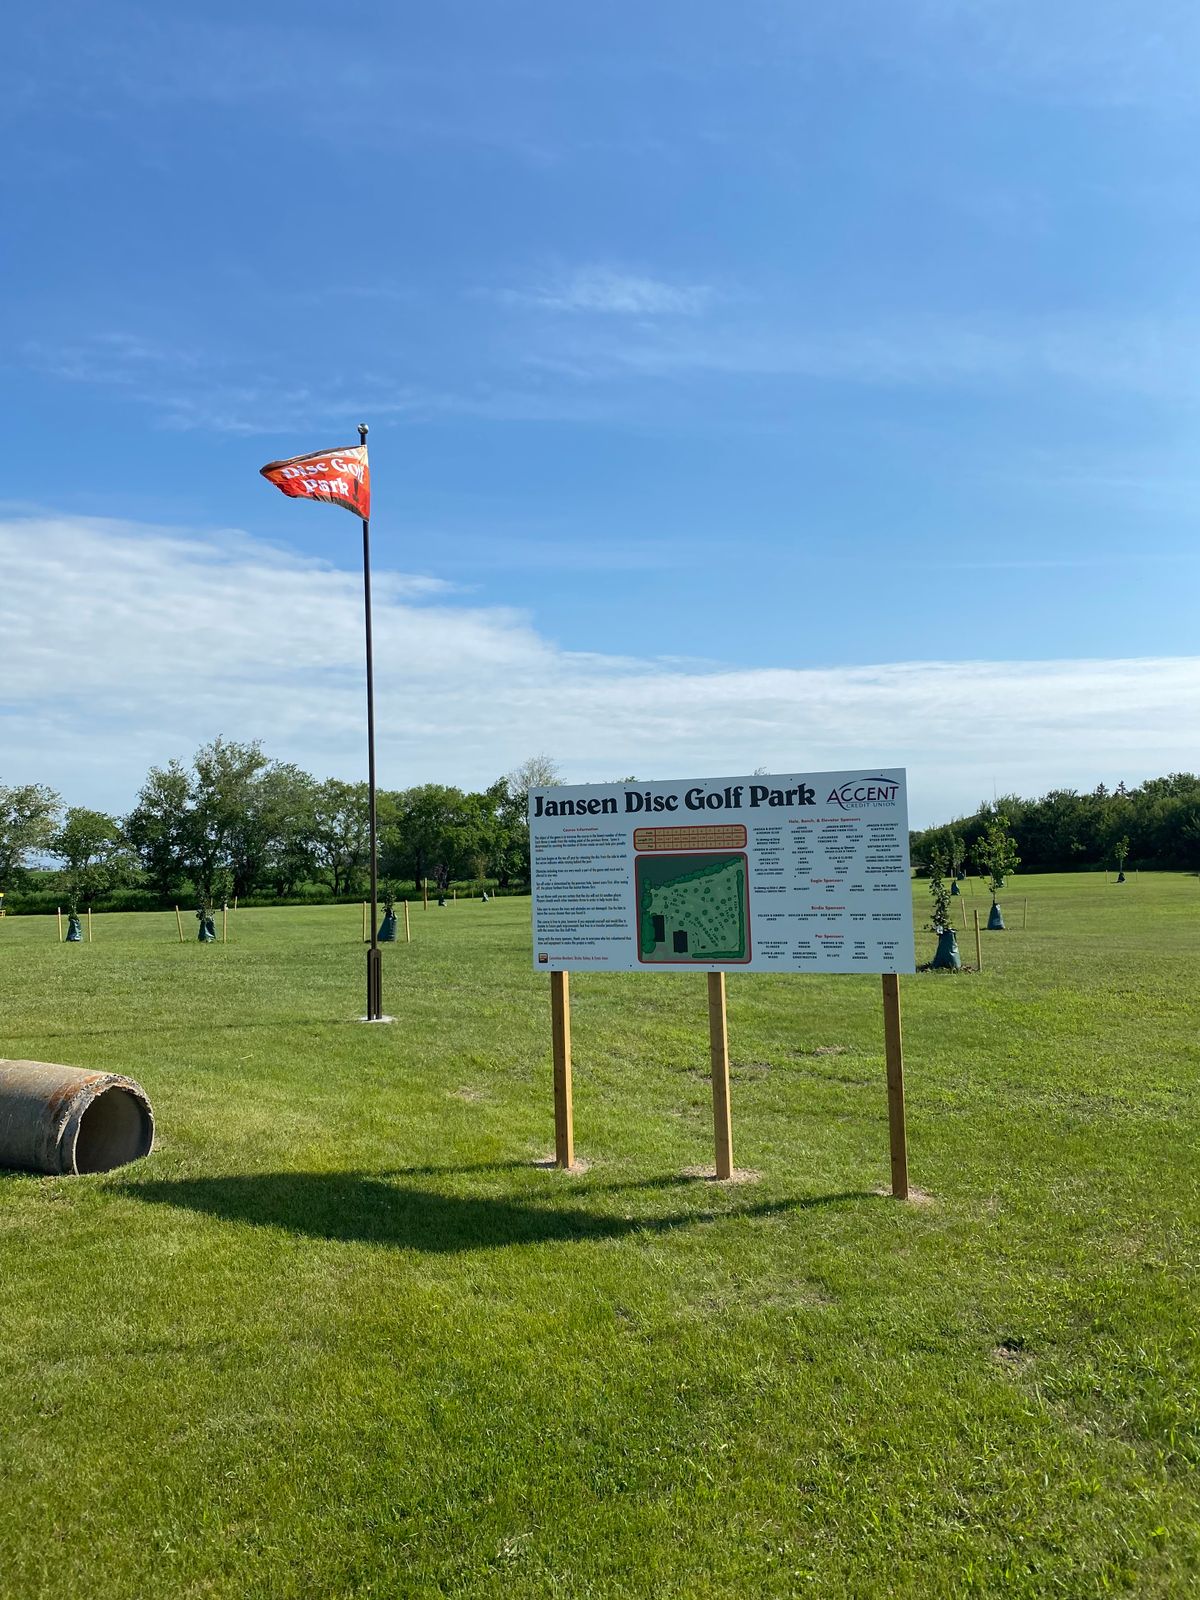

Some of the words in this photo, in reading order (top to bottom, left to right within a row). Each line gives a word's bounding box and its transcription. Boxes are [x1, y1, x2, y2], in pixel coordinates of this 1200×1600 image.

[281, 463, 328, 479] Disc
[302, 478, 349, 496] Park
[534, 795, 618, 818] Jansen
[624, 791, 679, 813] Disc
[684, 785, 743, 811] Golf
[749, 783, 816, 807] Park
[826, 786, 899, 803] ACCENT
